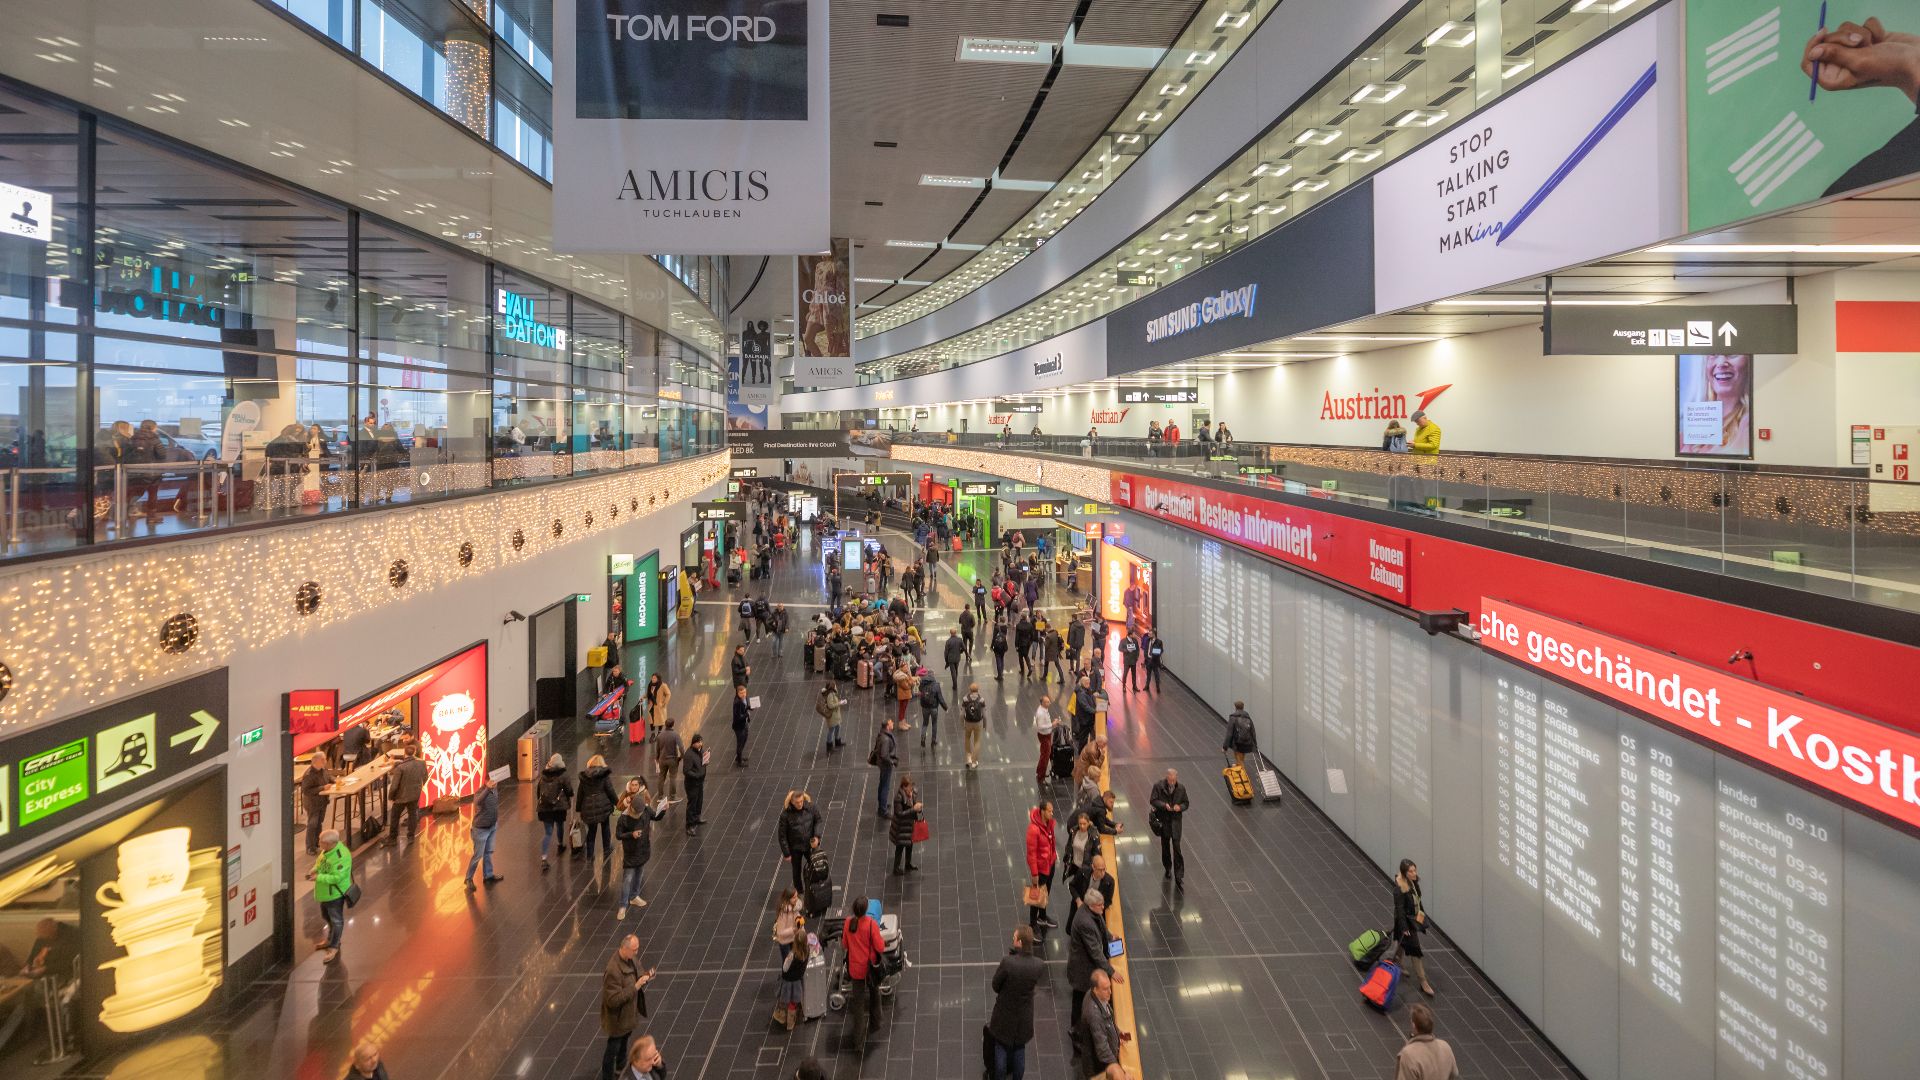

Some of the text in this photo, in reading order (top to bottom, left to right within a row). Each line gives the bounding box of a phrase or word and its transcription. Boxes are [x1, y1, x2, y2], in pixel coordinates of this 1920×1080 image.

[607, 14, 776, 42] TOM FORD
[1450, 127, 1493, 164] STOP
[616, 169, 769, 202] AMICIS
[1437, 150, 1510, 197] TALKING
[643, 209, 742, 218] TUCHLAUBEN
[1447, 185, 1498, 222] START
[1440, 221, 1503, 254] MAKing
[802, 289, 847, 304] Chloé
[1146, 283, 1258, 343] SAMSUNG Galaxy
[506, 314, 556, 348] DATION
[1613, 329, 1646, 338] Ausgang
[1631, 338, 1646, 346] Exit
[808, 367, 843, 376] AMICIS
[1057, 352, 1063, 370] 3
[1091, 408, 1119, 424] Austrian
[1320, 387, 1408, 420] Austrian
[1145, 485, 1157, 509] Gut
[1200, 497, 1241, 536] Bestens
[1245, 507, 1318, 562] informiert.
[1369, 538, 1404, 567] Kronen
[1370, 561, 1404, 593] Zeitung
[1527, 630, 1721, 727] geschändet
[299, 704, 325, 712] ANKER
[1514, 685, 1828, 842] 09:20 GRAZ OS 970 landed 09:10
[1514, 699, 1793, 849] 09:25 ZAGREB OS 682 approaching
[25, 775, 57, 797] City
[25, 781, 83, 815] Express
[1514, 713, 1538, 731] 09:30
[1545, 728, 1600, 765] NUREMBERG
[1620, 767, 1637, 783] EW
[1719, 821, 1777, 858] expected
[1786, 854, 1828, 886] 09:34
[1514, 727, 1828, 906] 09:30 MUNICH OS 112 expected 09:38
[1514, 740, 1793, 911] 09:30 LEIPZIG OS 216 approaching
[1514, 754, 1538, 775] 09:40
[1545, 772, 1588, 805] ISTANBUL
[1620, 817, 1636, 834] PC
[1650, 834, 1673, 856] 901
[1719, 878, 1777, 919] expected
[1514, 768, 1538, 789] 09:50
[1545, 787, 1571, 810] SOFIA
[1719, 896, 1777, 939] expected
[1786, 937, 1828, 972] 10:01
[1515, 824, 1538, 846] 10:05
[1545, 844, 1572, 872] MILAN
[1577, 867, 1597, 887] MXP
[1621, 899, 1637, 917] OS
[1515, 796, 1538, 817] 10:00
[1545, 815, 1585, 850] HELSINKI
[1621, 866, 1637, 883] AY
[1650, 886, 1681, 914] 1471
[1719, 934, 1777, 979] expected
[1545, 801, 1590, 837] HANOVER
[1620, 849, 1638, 866] EW
[1719, 915, 1777, 959] expected
[1515, 810, 1538, 831] 10:00
[1545, 830, 1573, 856] OHRID
[1719, 953, 1777, 1000] expected
[1515, 866, 1538, 889] 10:10
[1545, 888, 1601, 939] FRANKFURT
[1621, 948, 1636, 967] LH
[1650, 972, 1681, 1004] 1234
[1515, 838, 1538, 860] 10:05
[1545, 859, 1601, 908] BARCELONA
[1650, 937, 1681, 968] 8714
[1719, 991, 1777, 1040] expected
[1515, 851, 1538, 874] 10:10
[1719, 1009, 1777, 1060] expected
